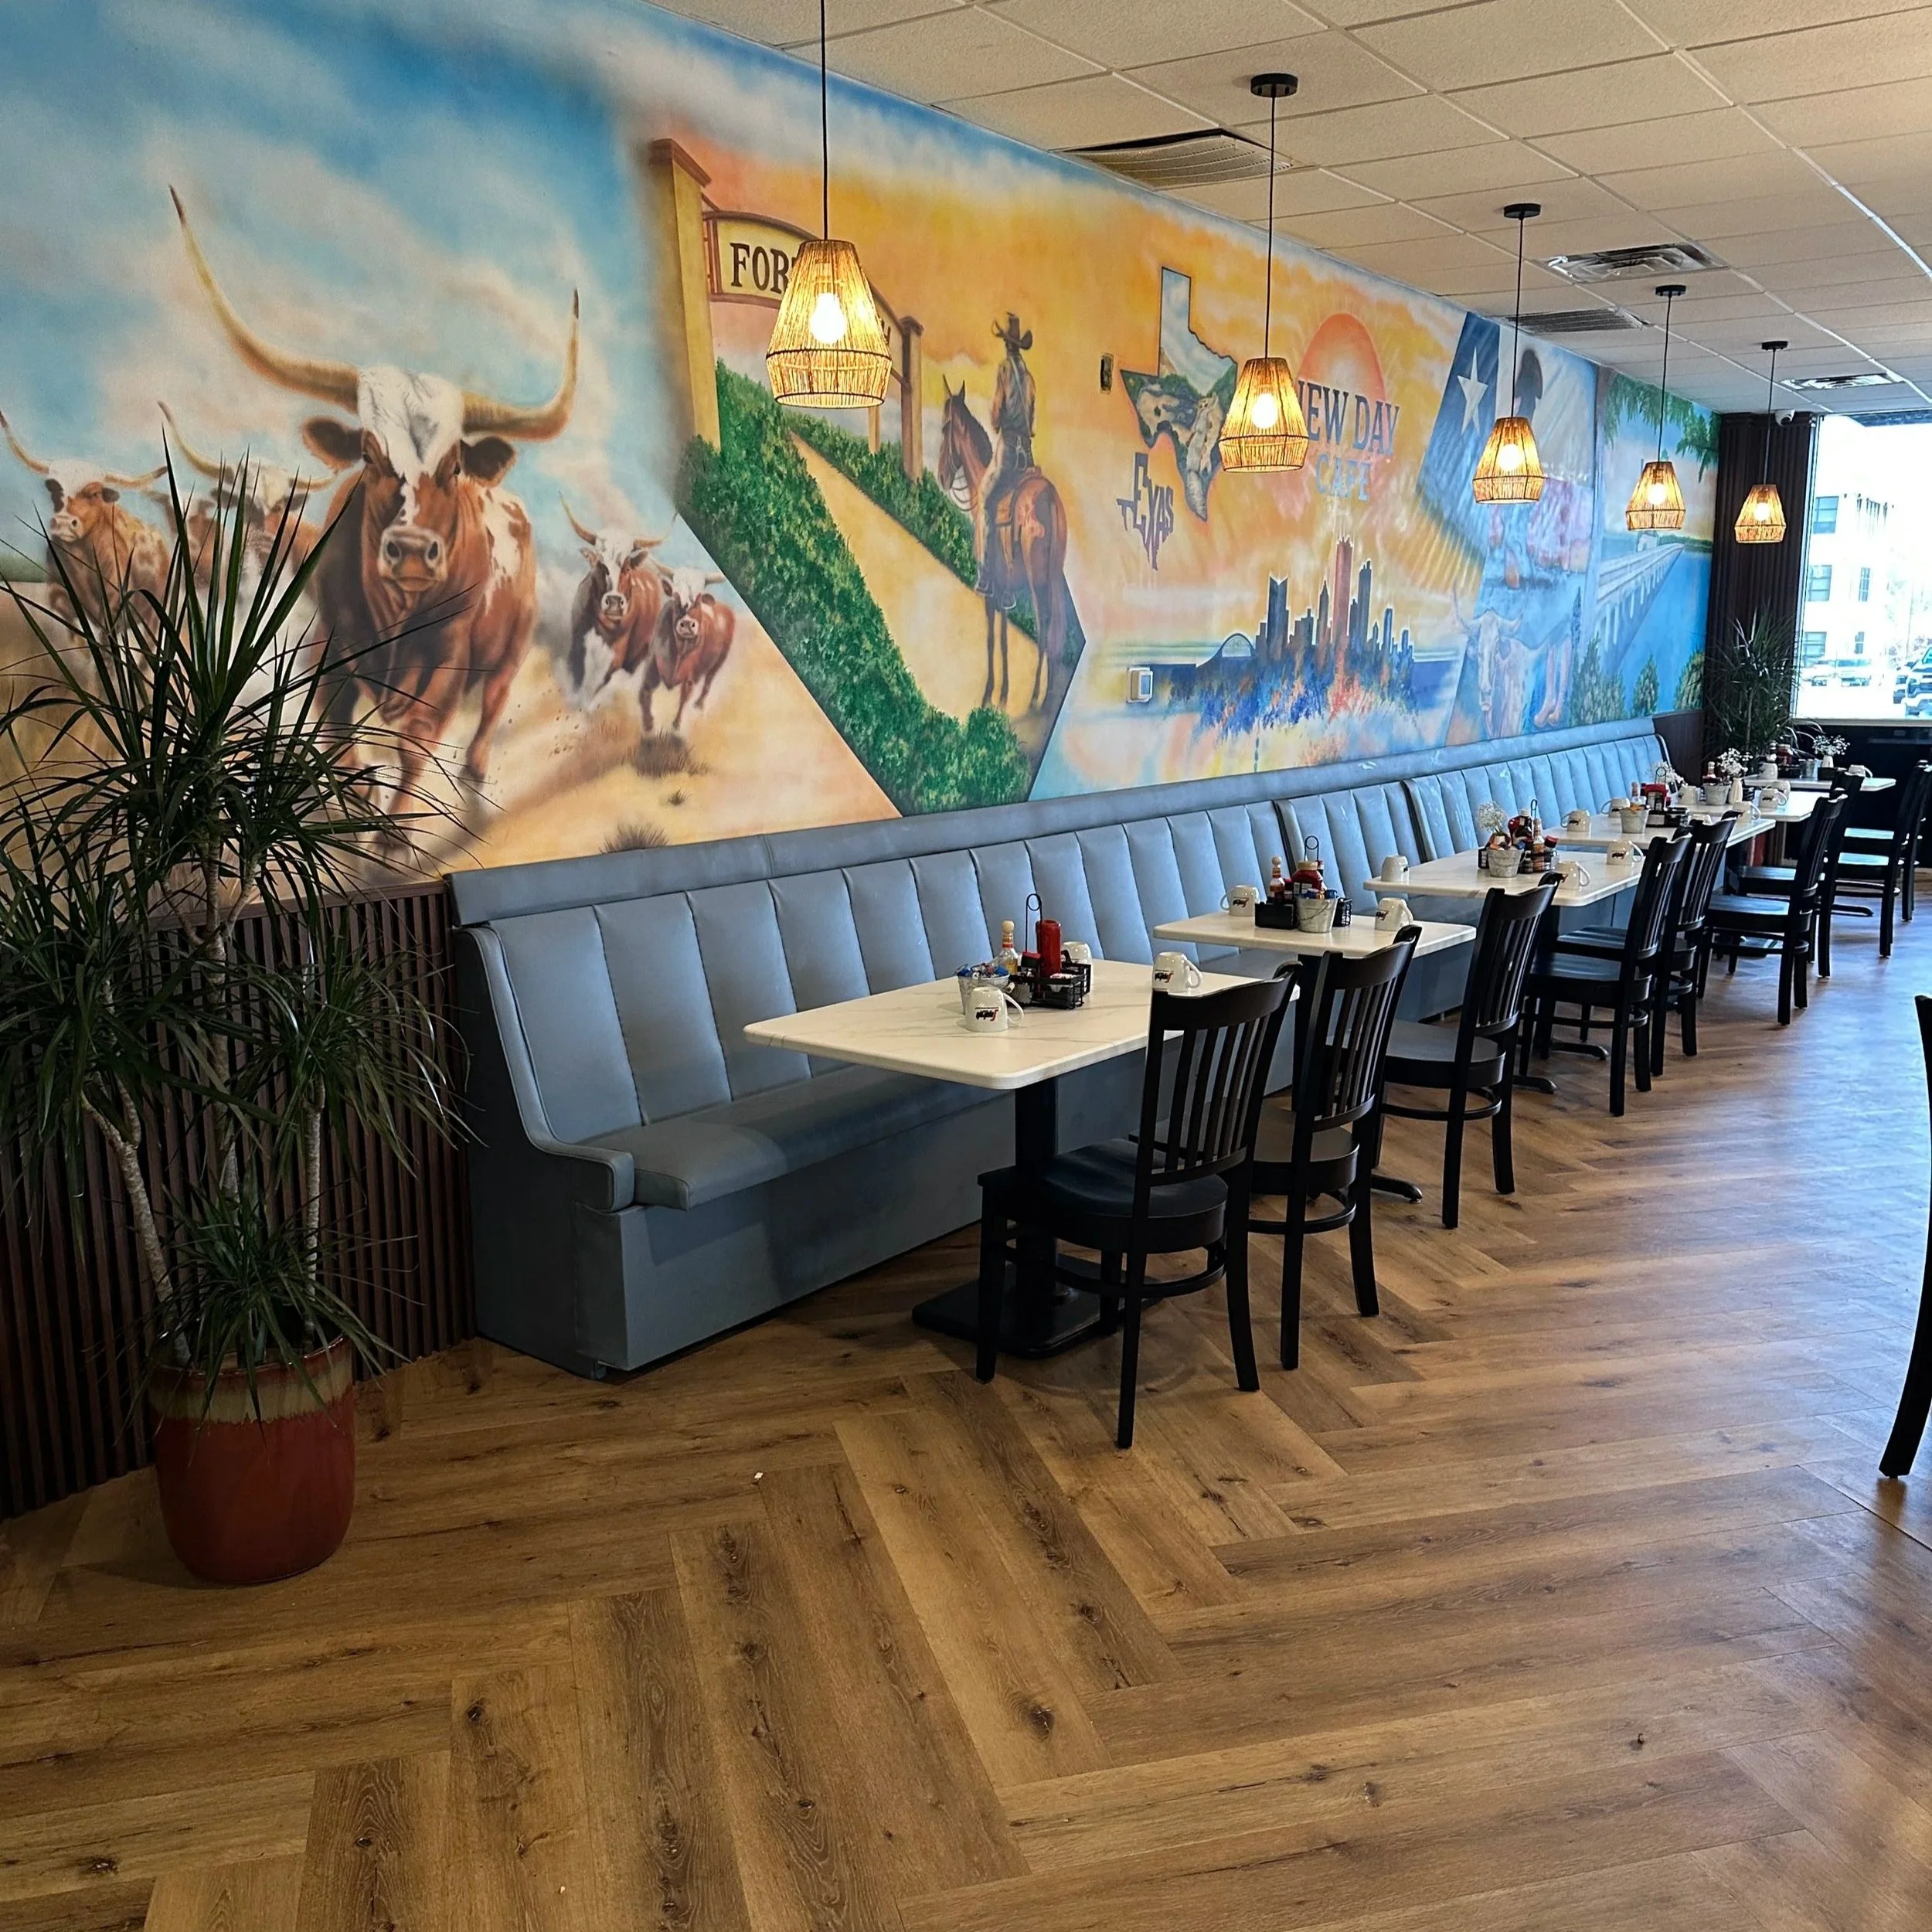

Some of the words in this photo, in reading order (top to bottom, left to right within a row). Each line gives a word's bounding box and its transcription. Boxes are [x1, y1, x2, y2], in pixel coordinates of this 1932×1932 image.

[730, 242, 799, 294] FOR
[1353, 394, 1400, 456] DAY
[1116, 451, 1175, 571] TEXAS
